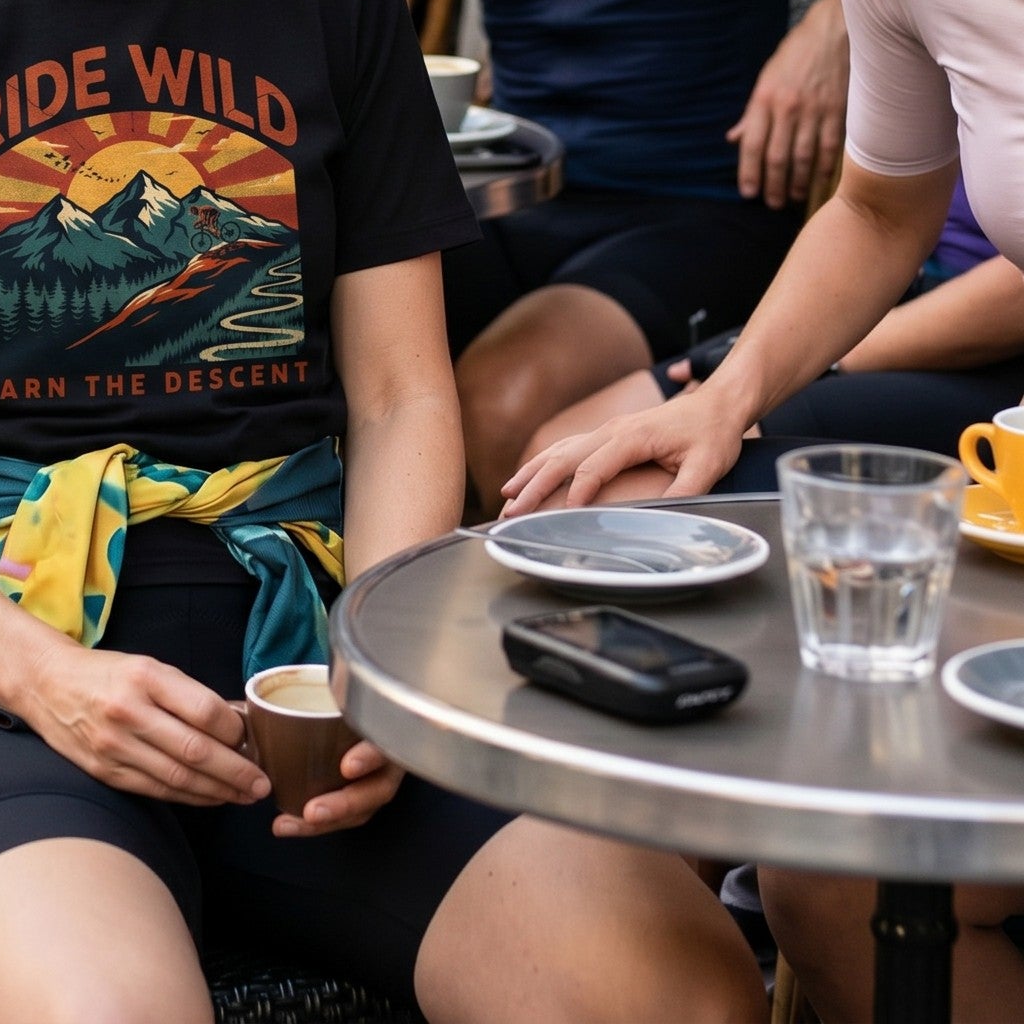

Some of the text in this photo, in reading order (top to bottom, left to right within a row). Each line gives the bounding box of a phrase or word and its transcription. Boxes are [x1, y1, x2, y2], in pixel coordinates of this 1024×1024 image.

[127, 43, 298, 147] WILD
[84, 374, 146, 397] THE
[165, 361, 309, 394] DESCENT
